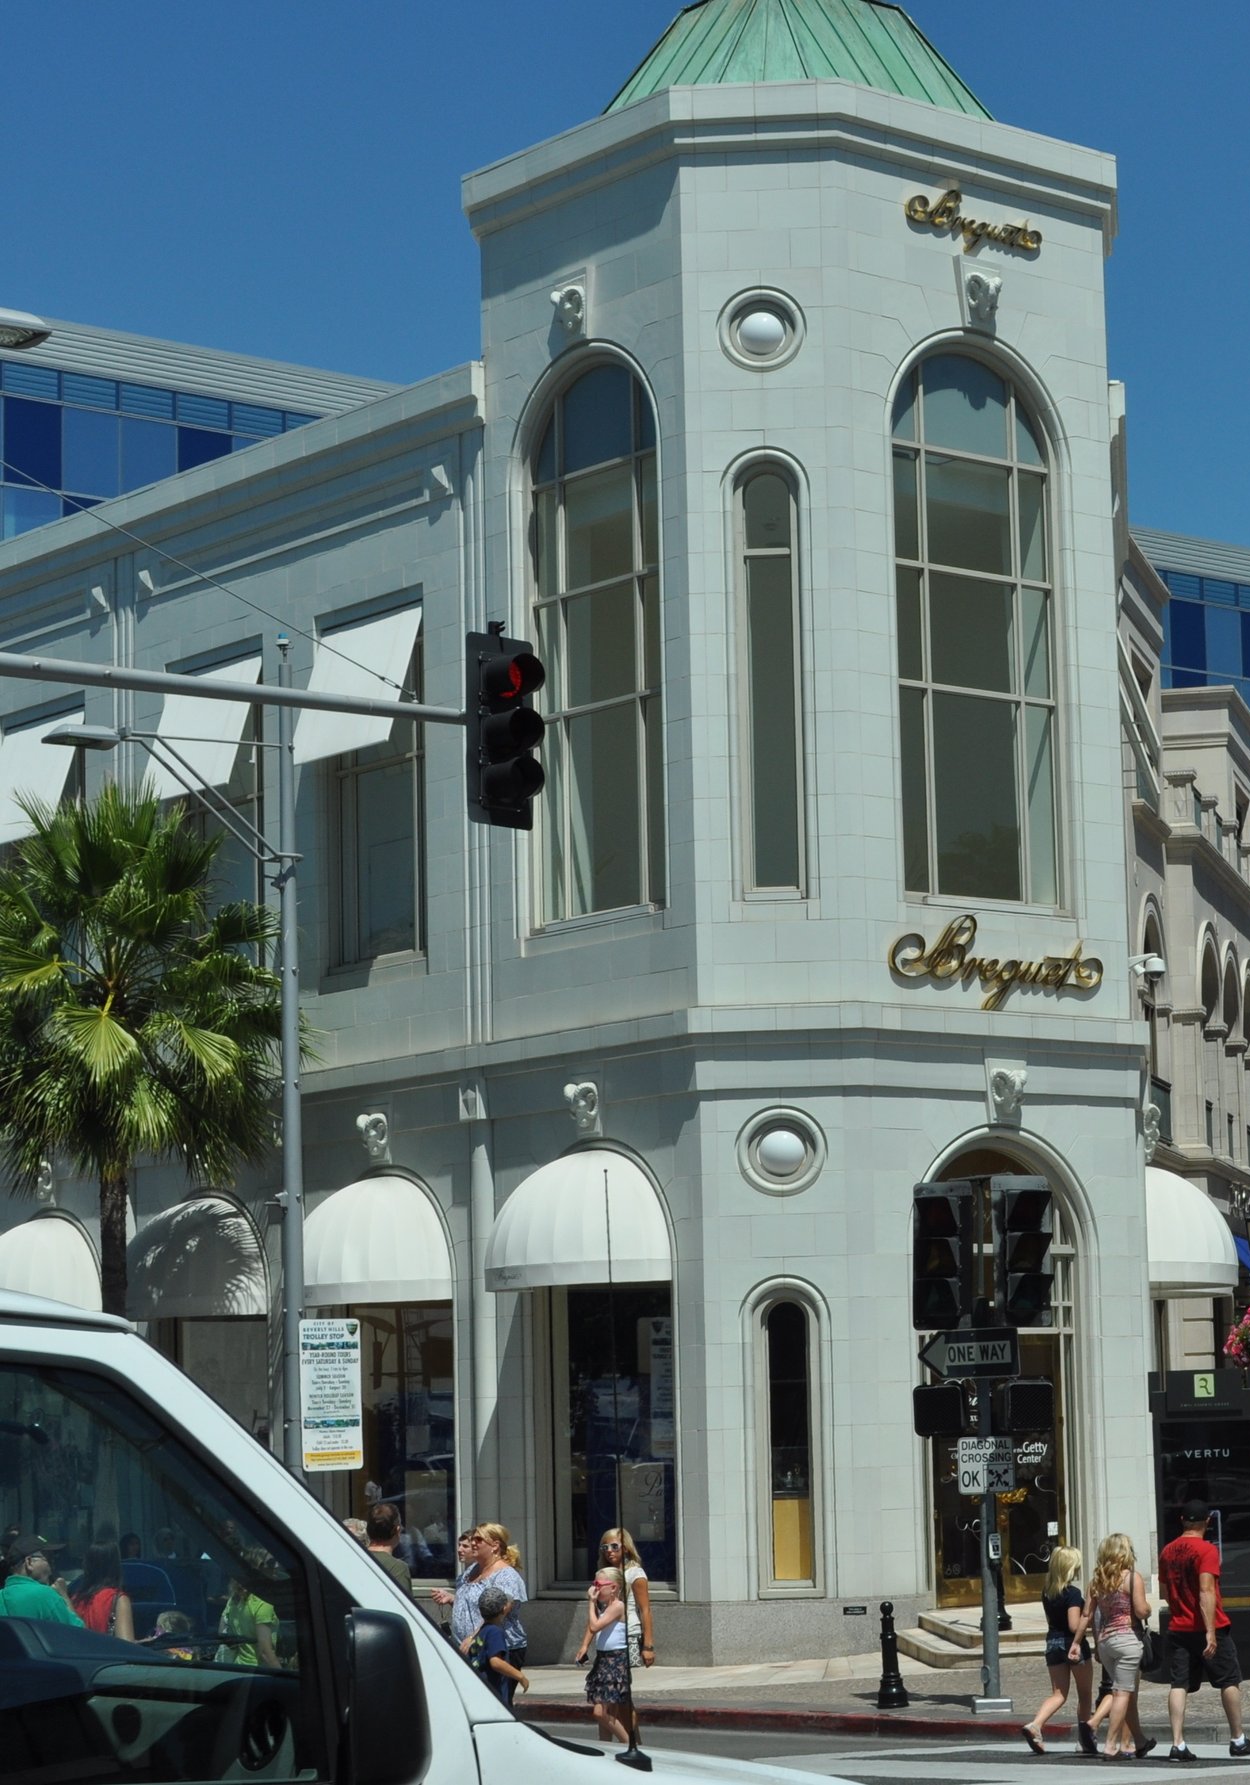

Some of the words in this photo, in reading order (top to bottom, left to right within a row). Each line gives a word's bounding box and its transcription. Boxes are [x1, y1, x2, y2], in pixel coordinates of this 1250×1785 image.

[888, 911, 1104, 1011] Breguet
[948, 1344, 975, 1363] ONE
[979, 1342, 1008, 1361] WAY
[961, 1439, 1010, 1451] DIAGONAL
[1022, 1441, 1048, 1456] Getty
[961, 1452, 1012, 1464] CROSSING
[1017, 1454, 1042, 1464] Center
[1184, 1448, 1230, 1459] VERTU
[961, 1470, 981, 1488] OK
